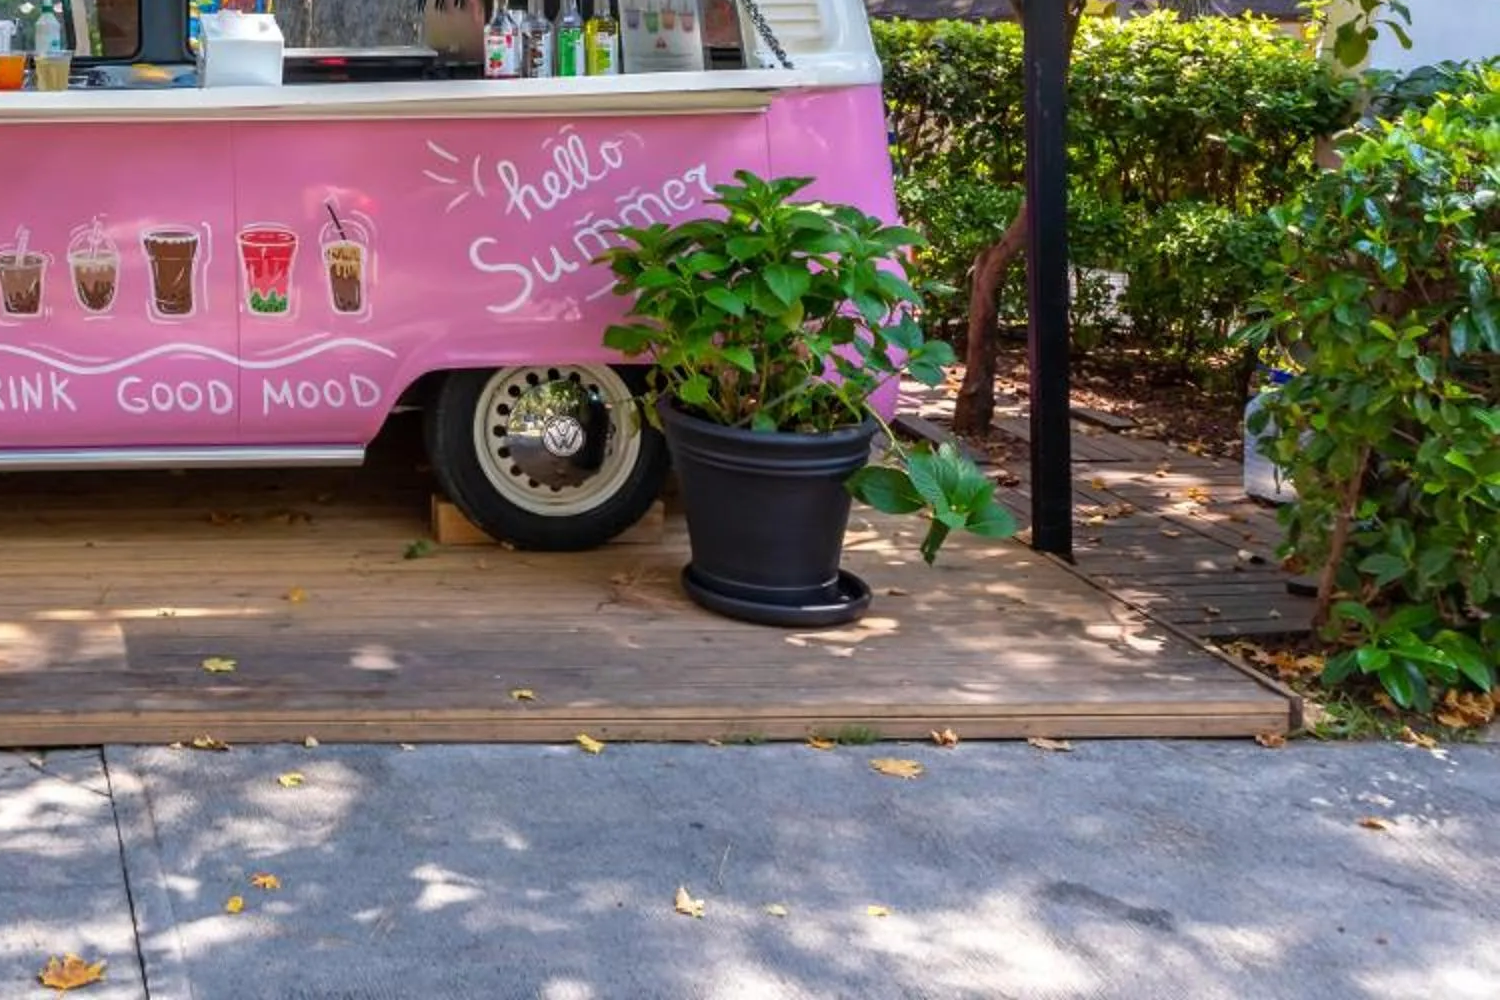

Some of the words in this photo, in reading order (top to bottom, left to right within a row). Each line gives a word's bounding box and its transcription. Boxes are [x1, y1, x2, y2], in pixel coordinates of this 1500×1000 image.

[497, 134, 624, 221] hello
[117, 376, 234, 414] GOOD
[262, 373, 381, 415] MOOD
